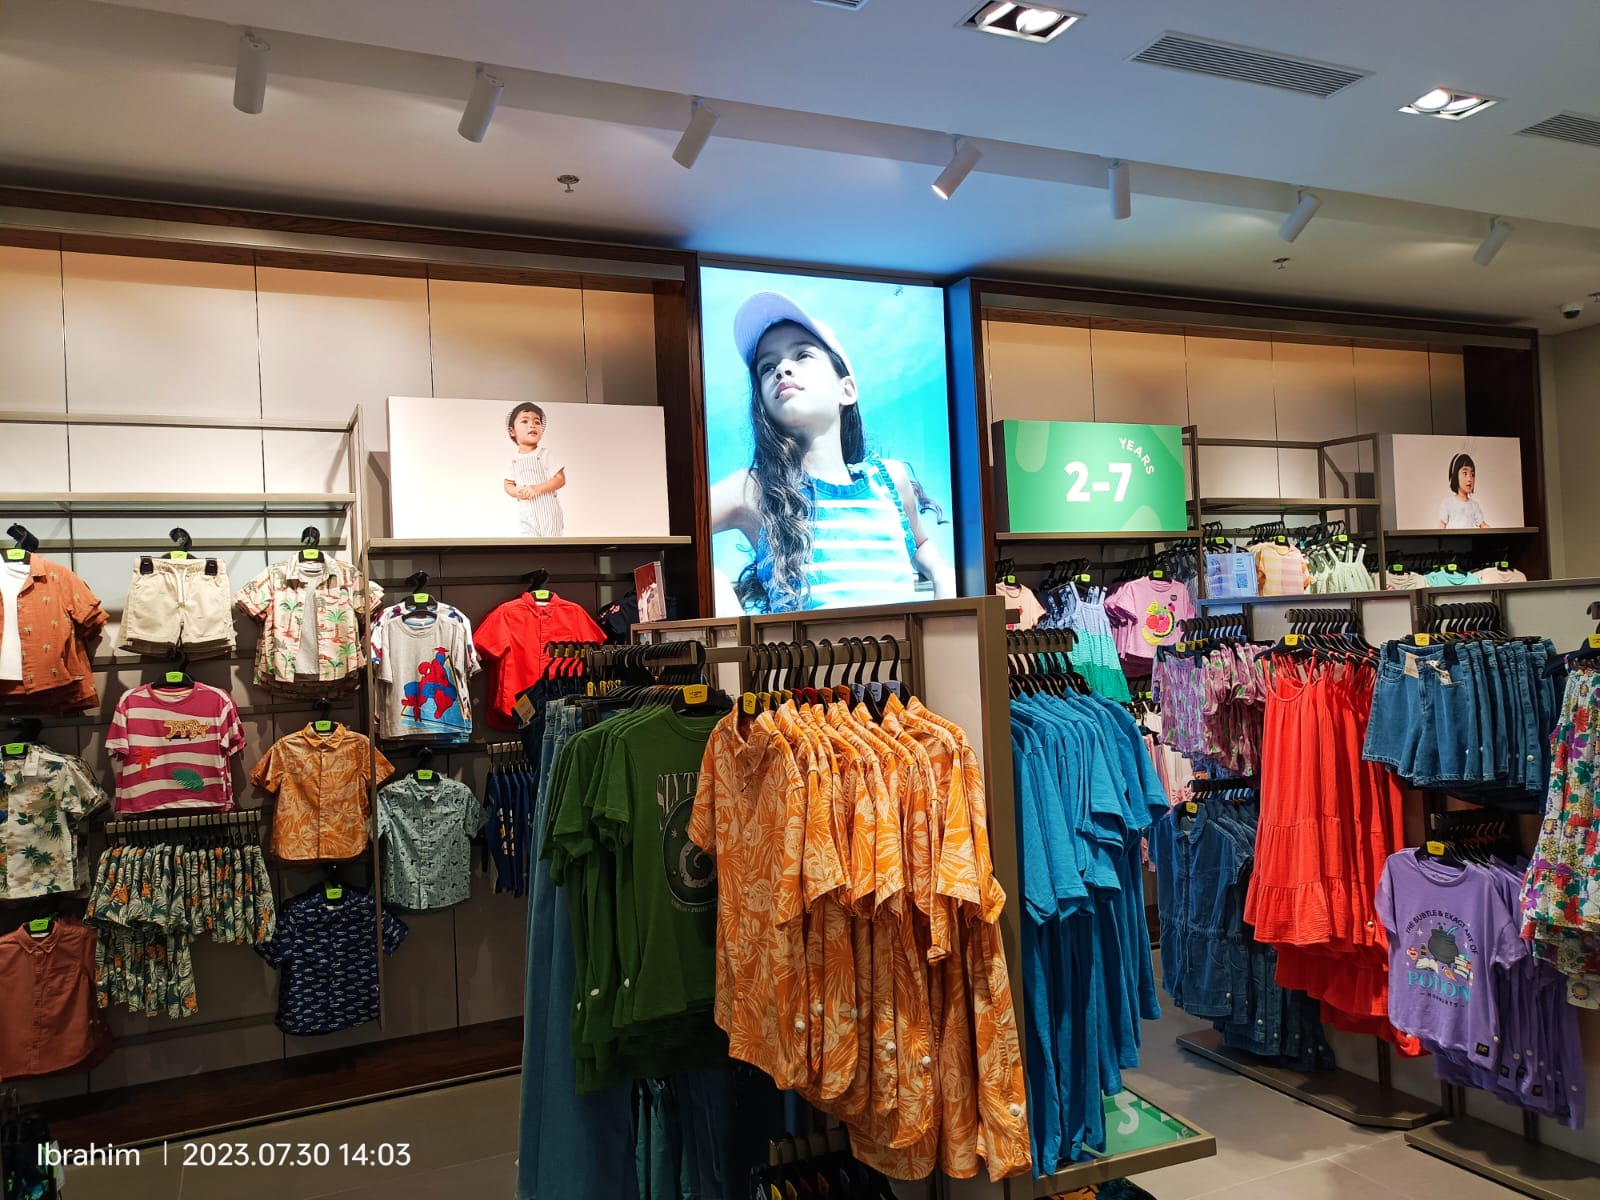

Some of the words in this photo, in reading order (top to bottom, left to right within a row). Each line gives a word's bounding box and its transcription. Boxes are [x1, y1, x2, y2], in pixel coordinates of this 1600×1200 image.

[1119, 437, 1155, 475] YEARS
[1063, 460, 1132, 502] 2-7
[1406, 919, 1416, 934] THE
[1413, 909, 1437, 924] SUBTLE
[1444, 912, 1467, 929] EXACT
[1464, 928, 1474, 943] ART
[1470, 944, 1479, 956] OF
[1407, 969, 1471, 1003] POTION
